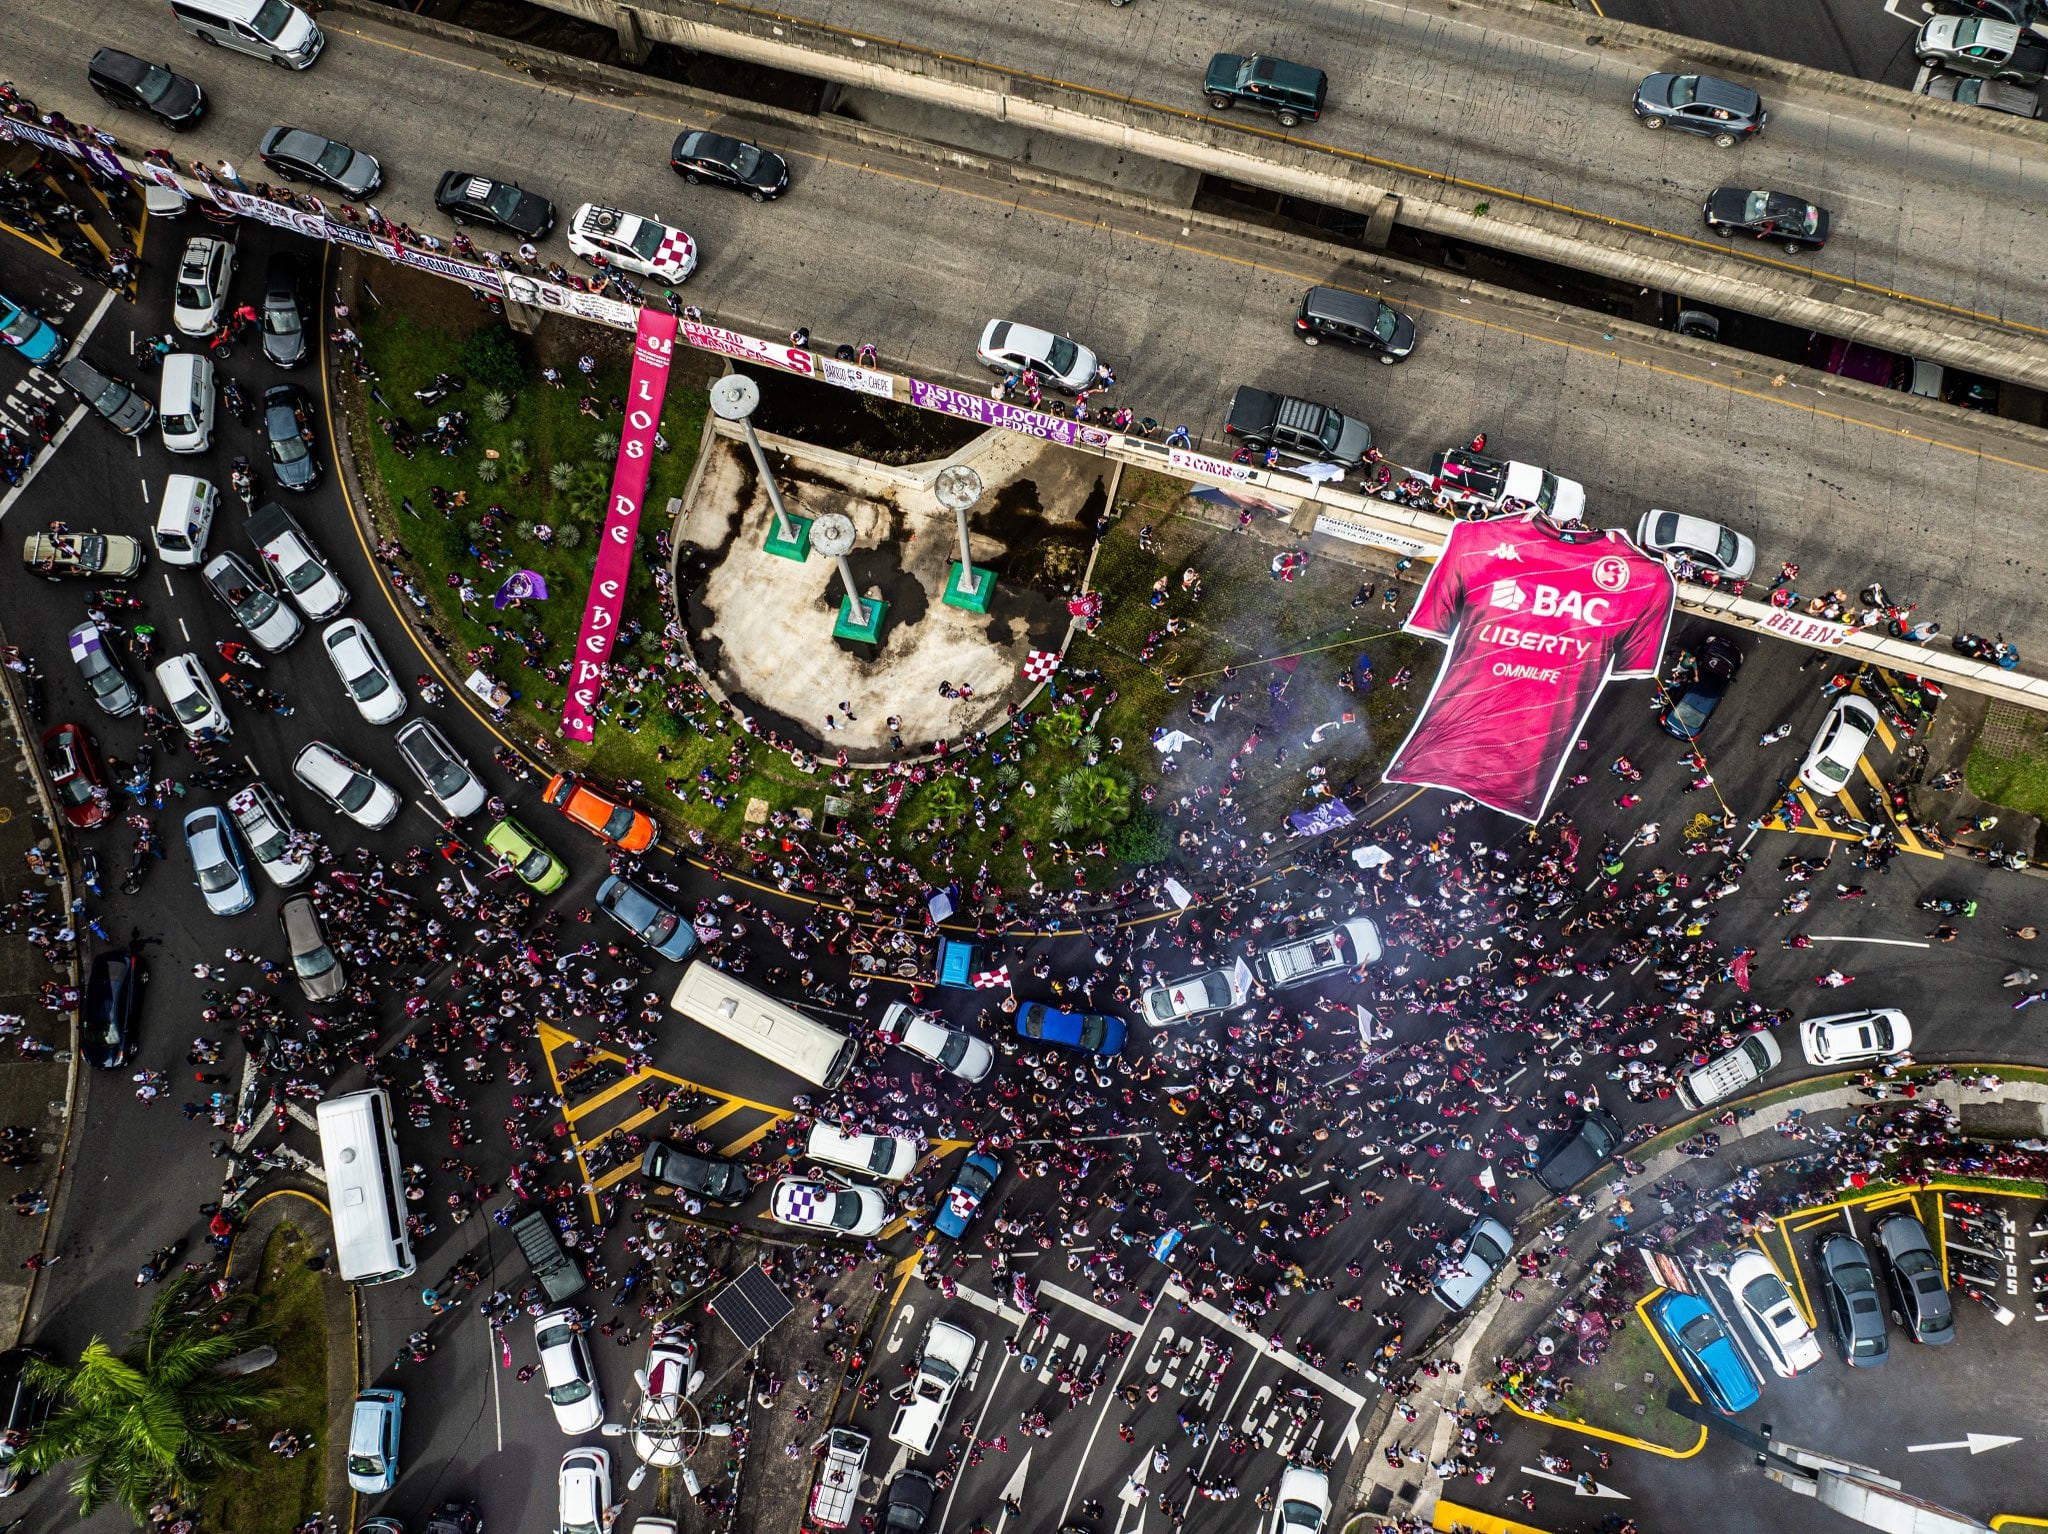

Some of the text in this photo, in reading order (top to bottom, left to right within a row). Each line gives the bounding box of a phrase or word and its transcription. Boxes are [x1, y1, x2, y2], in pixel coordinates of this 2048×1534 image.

[682, 320, 768, 351] CRUZADS
[786, 347, 812, 373] S
[912, 380, 983, 412] PASION
[986, 402, 1000, 416] Y
[1003, 405, 1070, 436] LOCURA
[946, 403, 1048, 438] SAN PEDRO
[1325, 525, 1382, 545] COSTA RICA
[1533, 583, 1610, 626] BAC
[1478, 624, 1592, 660] LIBERTY
[1766, 612, 1837, 644] BELEN
[1492, 662, 1562, 685] OMNILIFE
[2002, 1216, 2019, 1295] MOTOS
